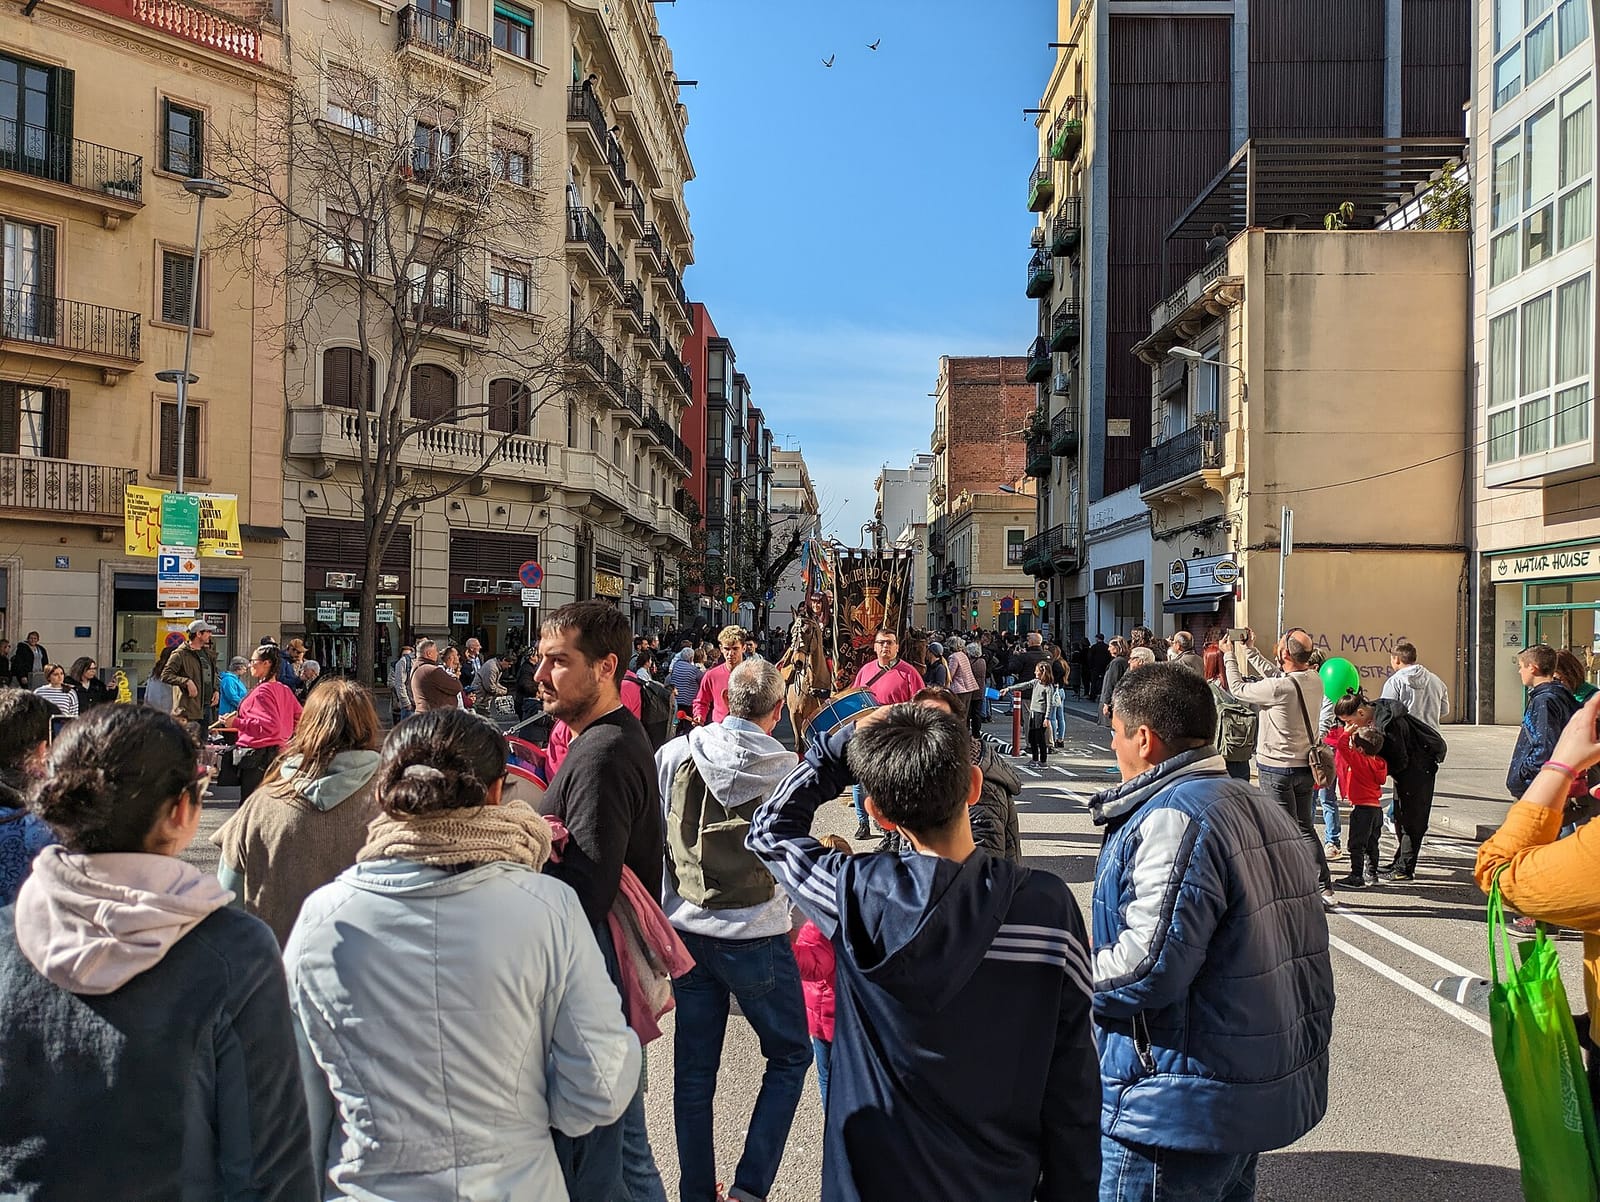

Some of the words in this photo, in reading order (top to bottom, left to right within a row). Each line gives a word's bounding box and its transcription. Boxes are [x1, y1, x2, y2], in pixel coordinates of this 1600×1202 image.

[163, 557, 175, 572] P
[1514, 556, 1549, 574] NATUR
[1552, 551, 1590, 570] HOUSE
